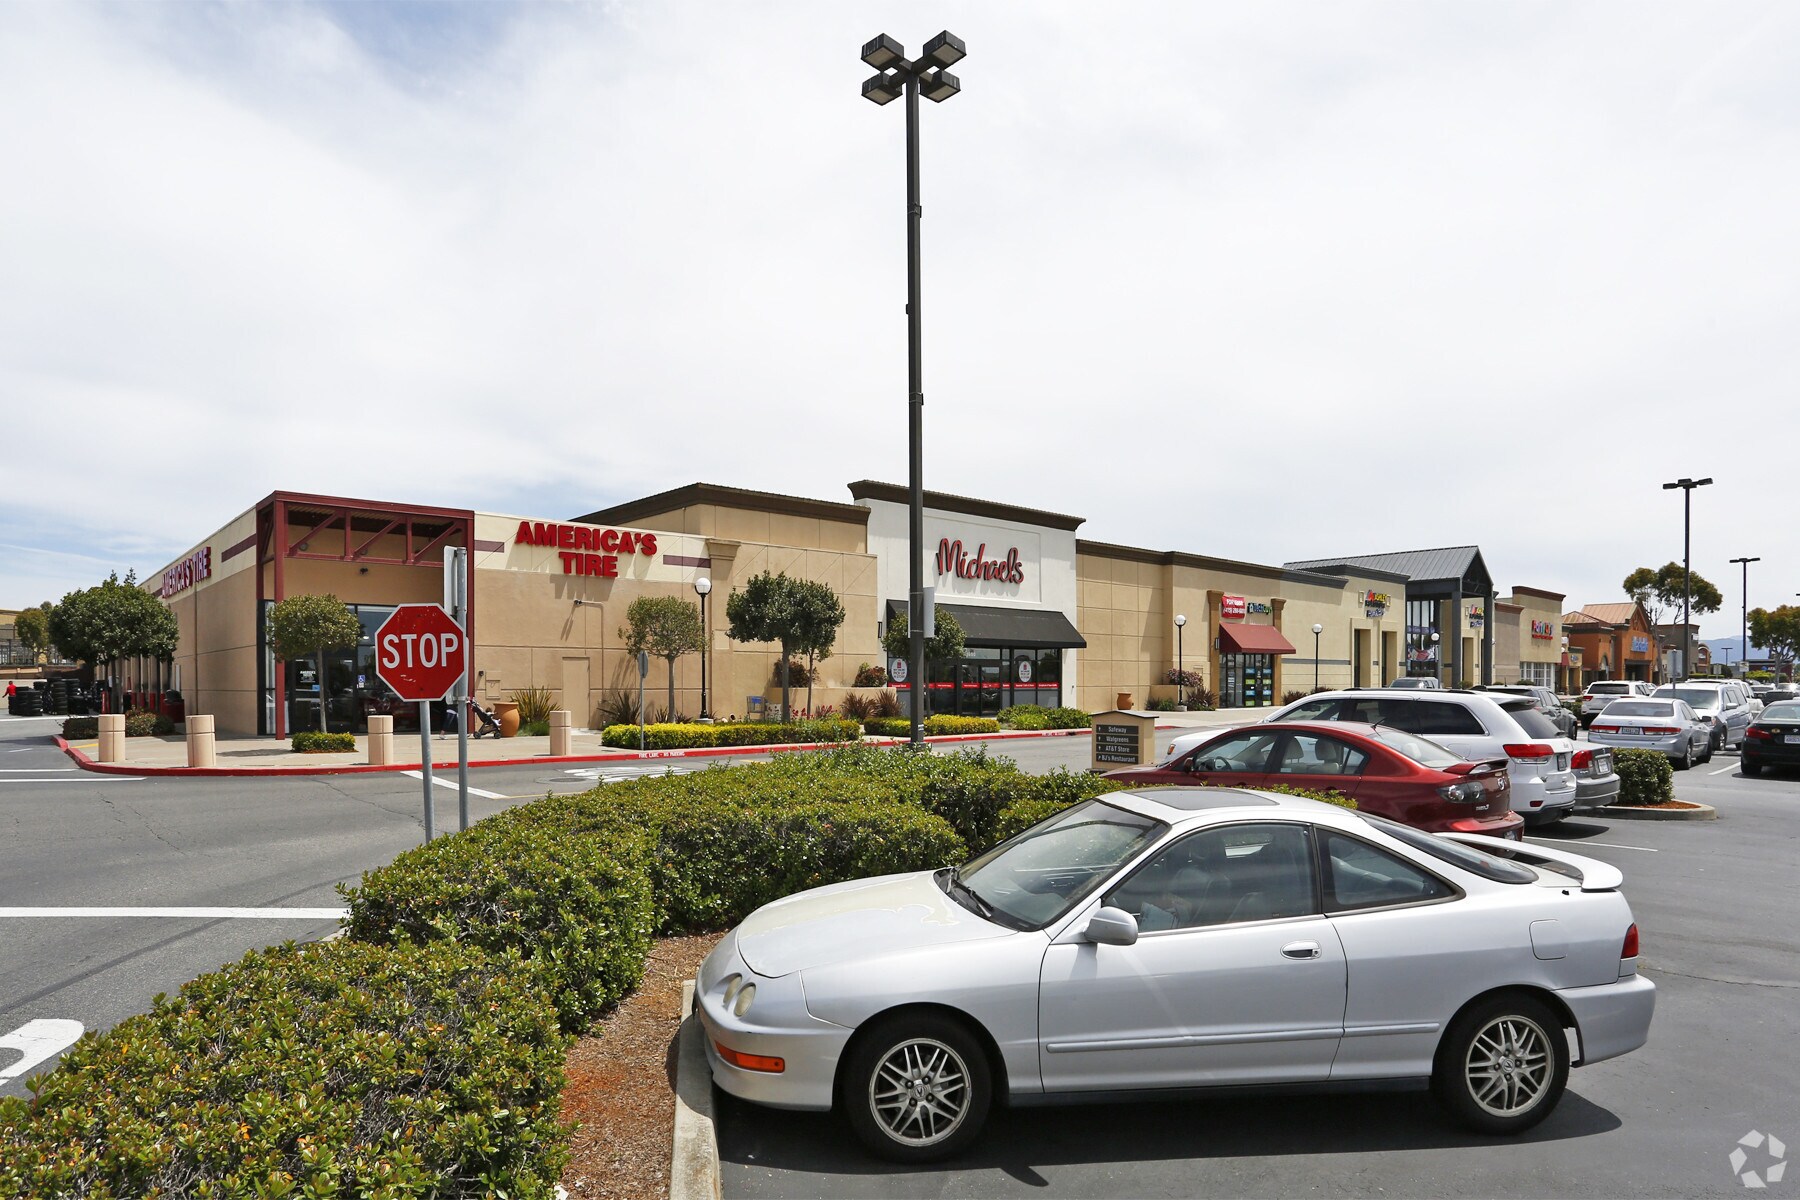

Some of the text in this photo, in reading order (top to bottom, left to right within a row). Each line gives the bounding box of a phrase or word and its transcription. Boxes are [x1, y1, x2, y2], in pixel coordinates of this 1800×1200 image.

[514, 520, 658, 556] AMERICA'S
[192, 546, 211, 583] TIRE
[558, 551, 619, 578] TIRE
[935, 537, 1024, 584] Michaels
[382, 632, 459, 669] STOP
